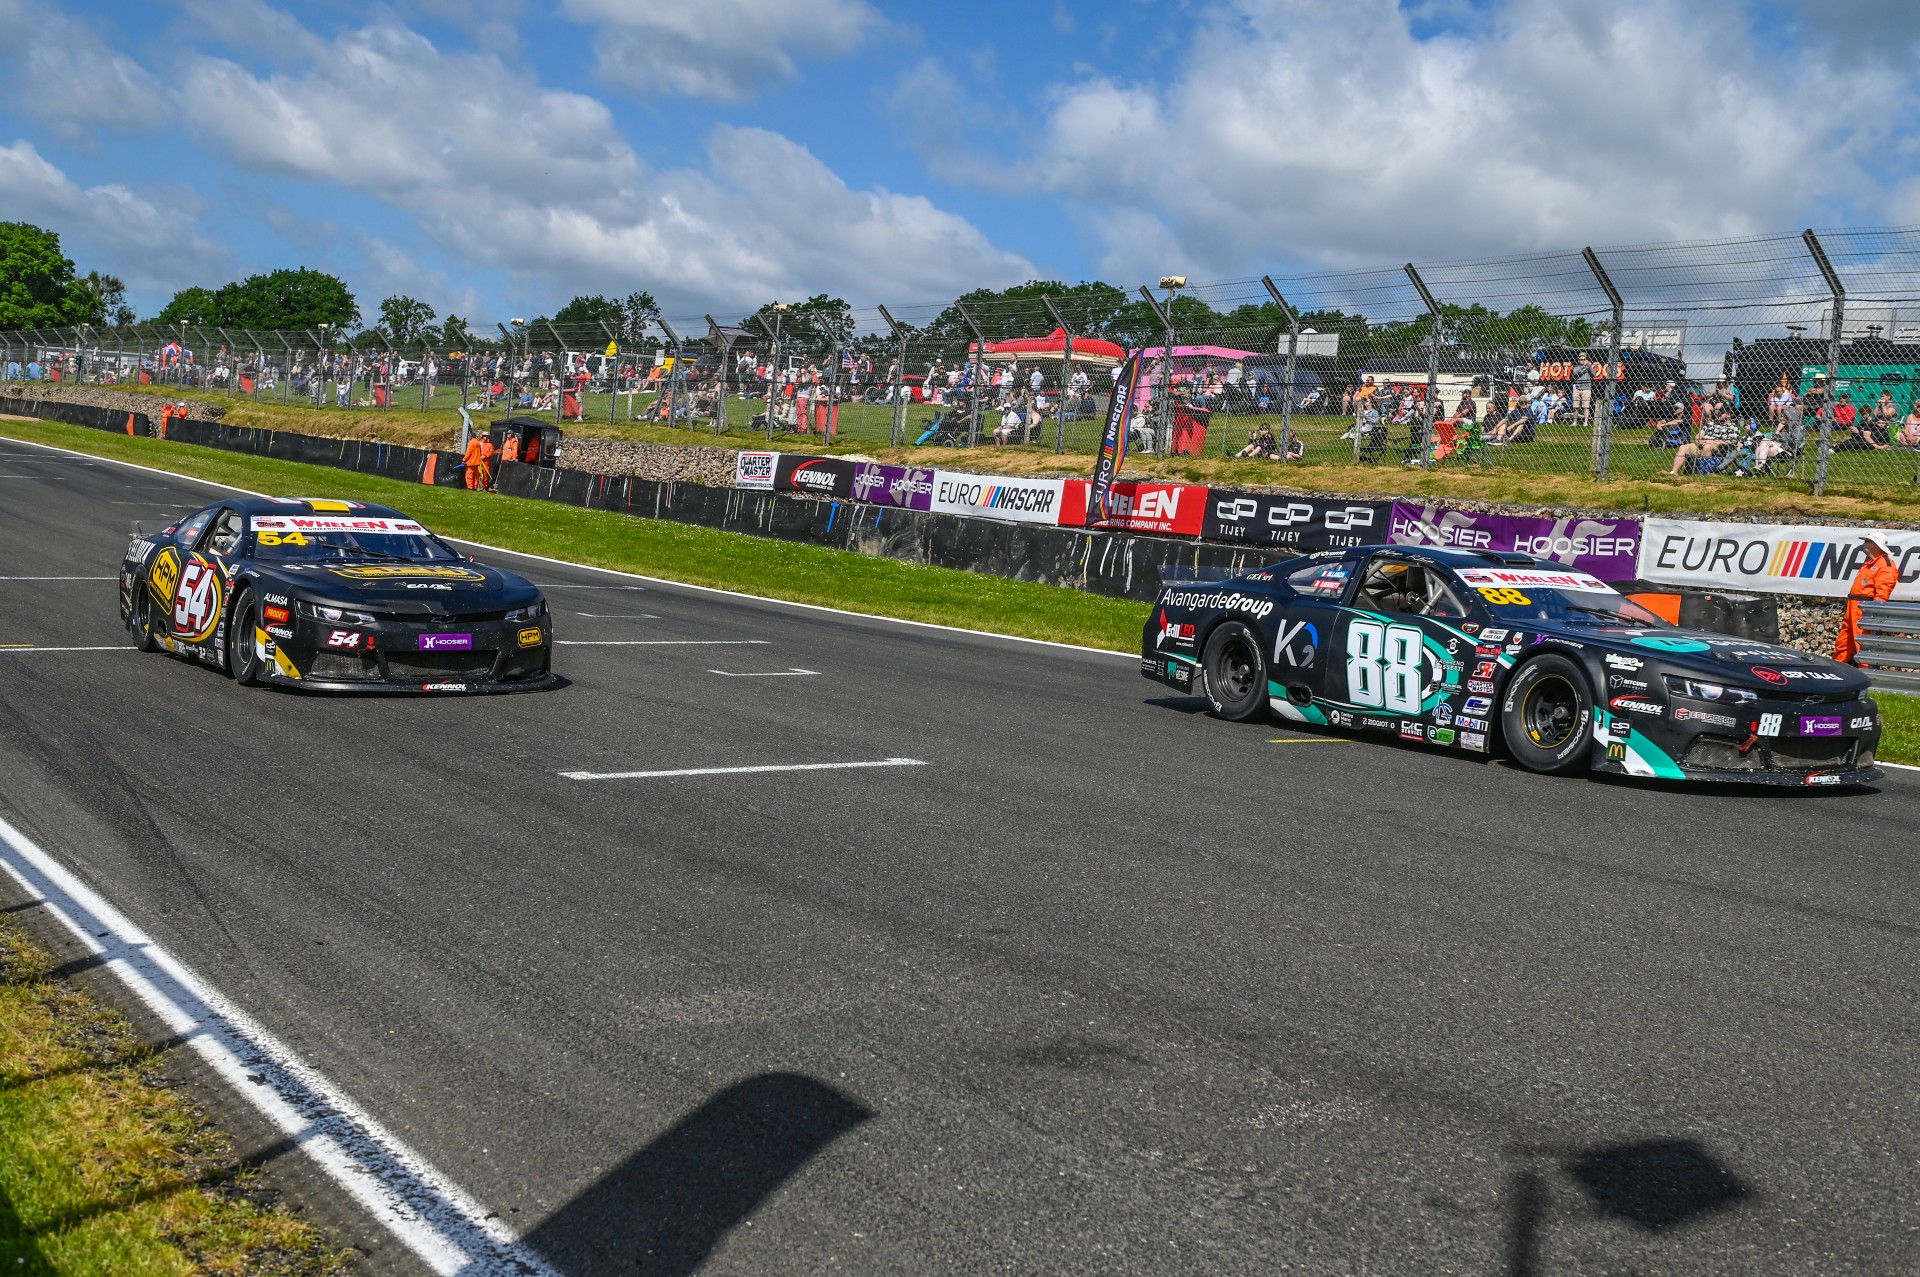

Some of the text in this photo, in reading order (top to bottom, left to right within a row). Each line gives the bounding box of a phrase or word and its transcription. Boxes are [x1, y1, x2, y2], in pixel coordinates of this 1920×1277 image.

[1540, 362, 1574, 381] HOT
[1106, 384, 1128, 440] NASCAR
[741, 456, 770, 470] QUARTER
[744, 466, 771, 476] MASTER
[794, 470, 836, 486] KENNOL
[854, 473, 884, 488] HOOSIER
[890, 478, 932, 494] HOOSIER
[938, 482, 1055, 512] EURO NASCAR
[290, 518, 388, 529] WHELEN
[1126, 520, 1158, 528] COMPANY
[1158, 522, 1172, 530] INC.
[1220, 525, 1246, 537] TIJEY
[258, 532, 308, 546] 54
[1271, 530, 1300, 543] TIJEY
[1392, 518, 1492, 548] HOOSIER
[1329, 535, 1362, 547] TIJEY
[1513, 534, 1636, 556] HOOSIER
[1656, 536, 1770, 576] EURO
[154, 554, 176, 592] HPM
[1490, 572, 1581, 586] WHELEN
[174, 560, 216, 636] 54
[264, 592, 288, 606] ALMASA
[1160, 588, 1274, 620] AvangardeGroup
[1477, 587, 1532, 606] 88
[266, 626, 292, 638] KENNOL
[327, 630, 362, 648] 54
[522, 632, 539, 642] HPM
[1544, 638, 1584, 649] HOOSIER
[1346, 618, 1424, 716] 88
[1468, 680, 1492, 688] QUARTER
[1614, 699, 1663, 713] KENNOL
[1457, 716, 1479, 728] Mobil
[1757, 713, 1783, 736] 88
[1557, 721, 1586, 759] HOOSIER
